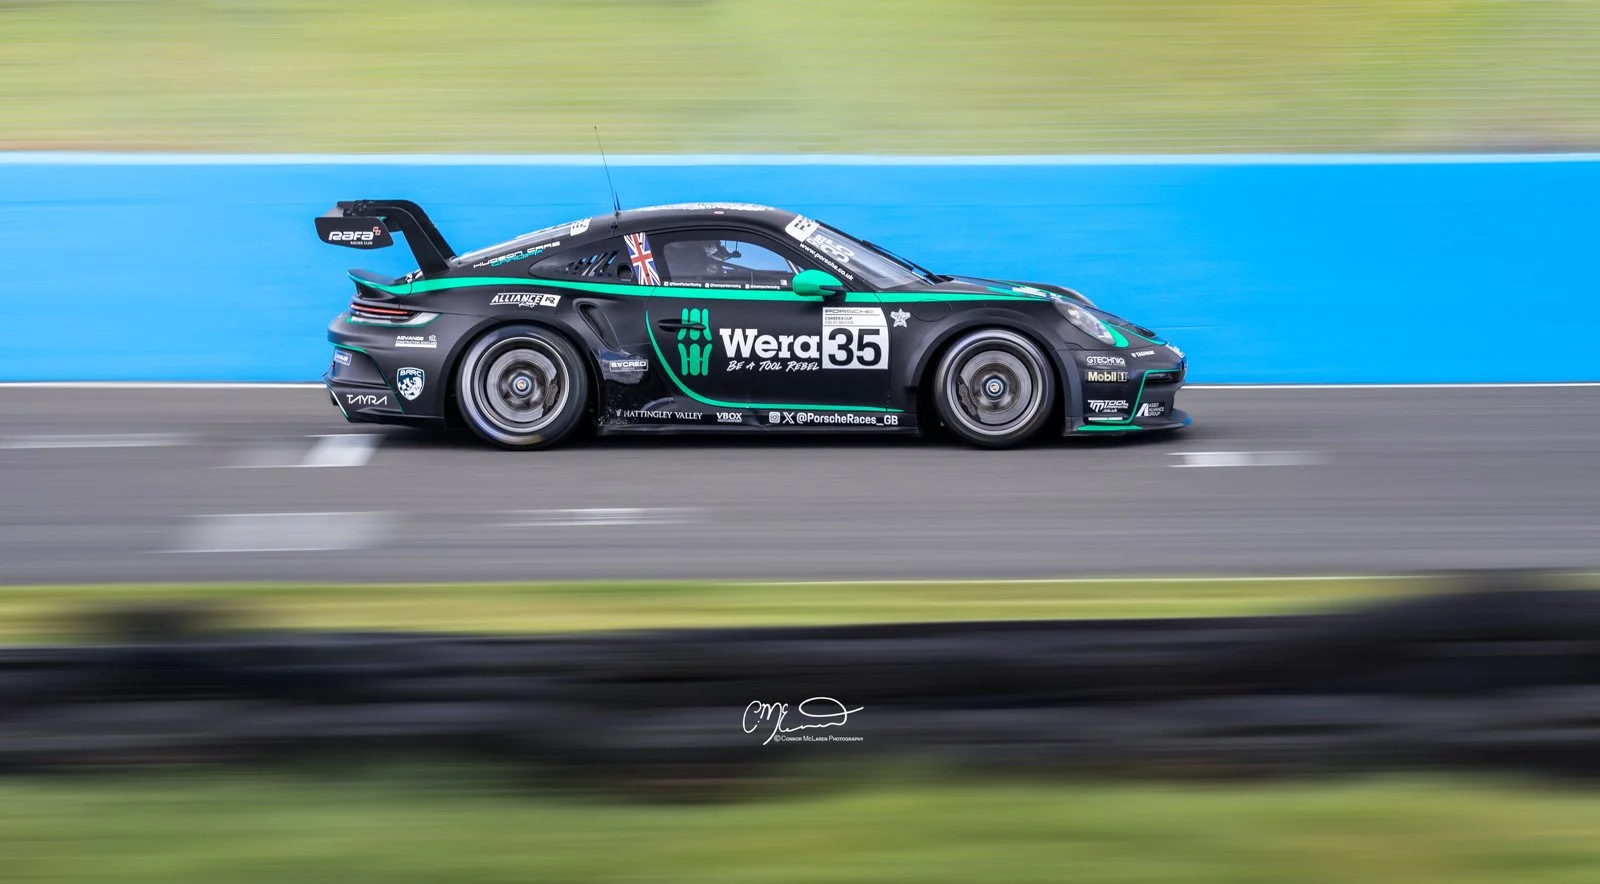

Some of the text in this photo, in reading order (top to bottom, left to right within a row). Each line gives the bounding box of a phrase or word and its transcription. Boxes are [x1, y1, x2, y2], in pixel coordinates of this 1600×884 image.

[800, 243, 853, 281] www.porsche.co.uk
[491, 294, 542, 303] ALLIANCE
[719, 328, 819, 358] Wera
[828, 328, 882, 366] 35
[727, 361, 819, 372] BE A TOOL REBEL
[400, 369, 421, 377] BARC
[1088, 372, 1116, 382] Mobil
[346, 394, 387, 405] TAYRA
[623, 410, 703, 420] HATTINGLEY VALLEY
[716, 412, 742, 420] VBOX
[796, 412, 898, 425] @PorscheRaces_GB
